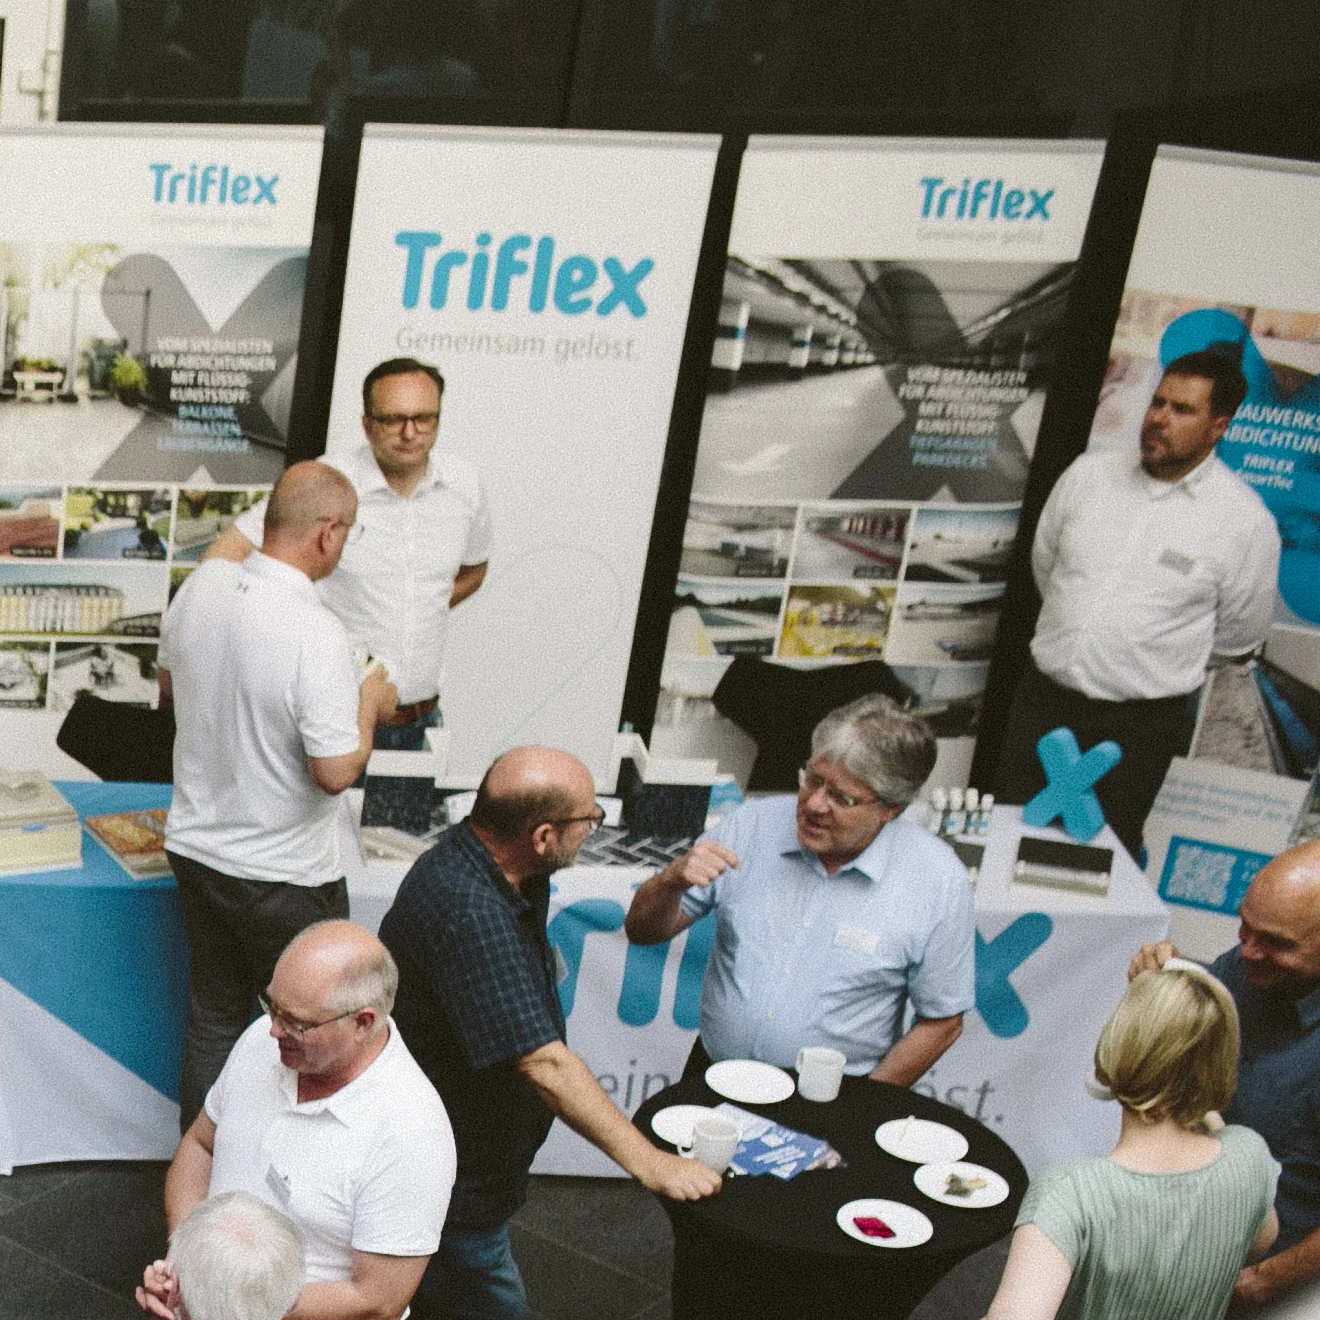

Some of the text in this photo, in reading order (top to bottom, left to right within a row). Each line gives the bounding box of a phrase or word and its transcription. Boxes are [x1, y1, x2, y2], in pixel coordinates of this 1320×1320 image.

[149, 163, 280, 205] Triflex
[920, 178, 1055, 221] Triflex
[394, 230, 655, 319] Triflex
[394, 328, 545, 358] Gemeinsam
